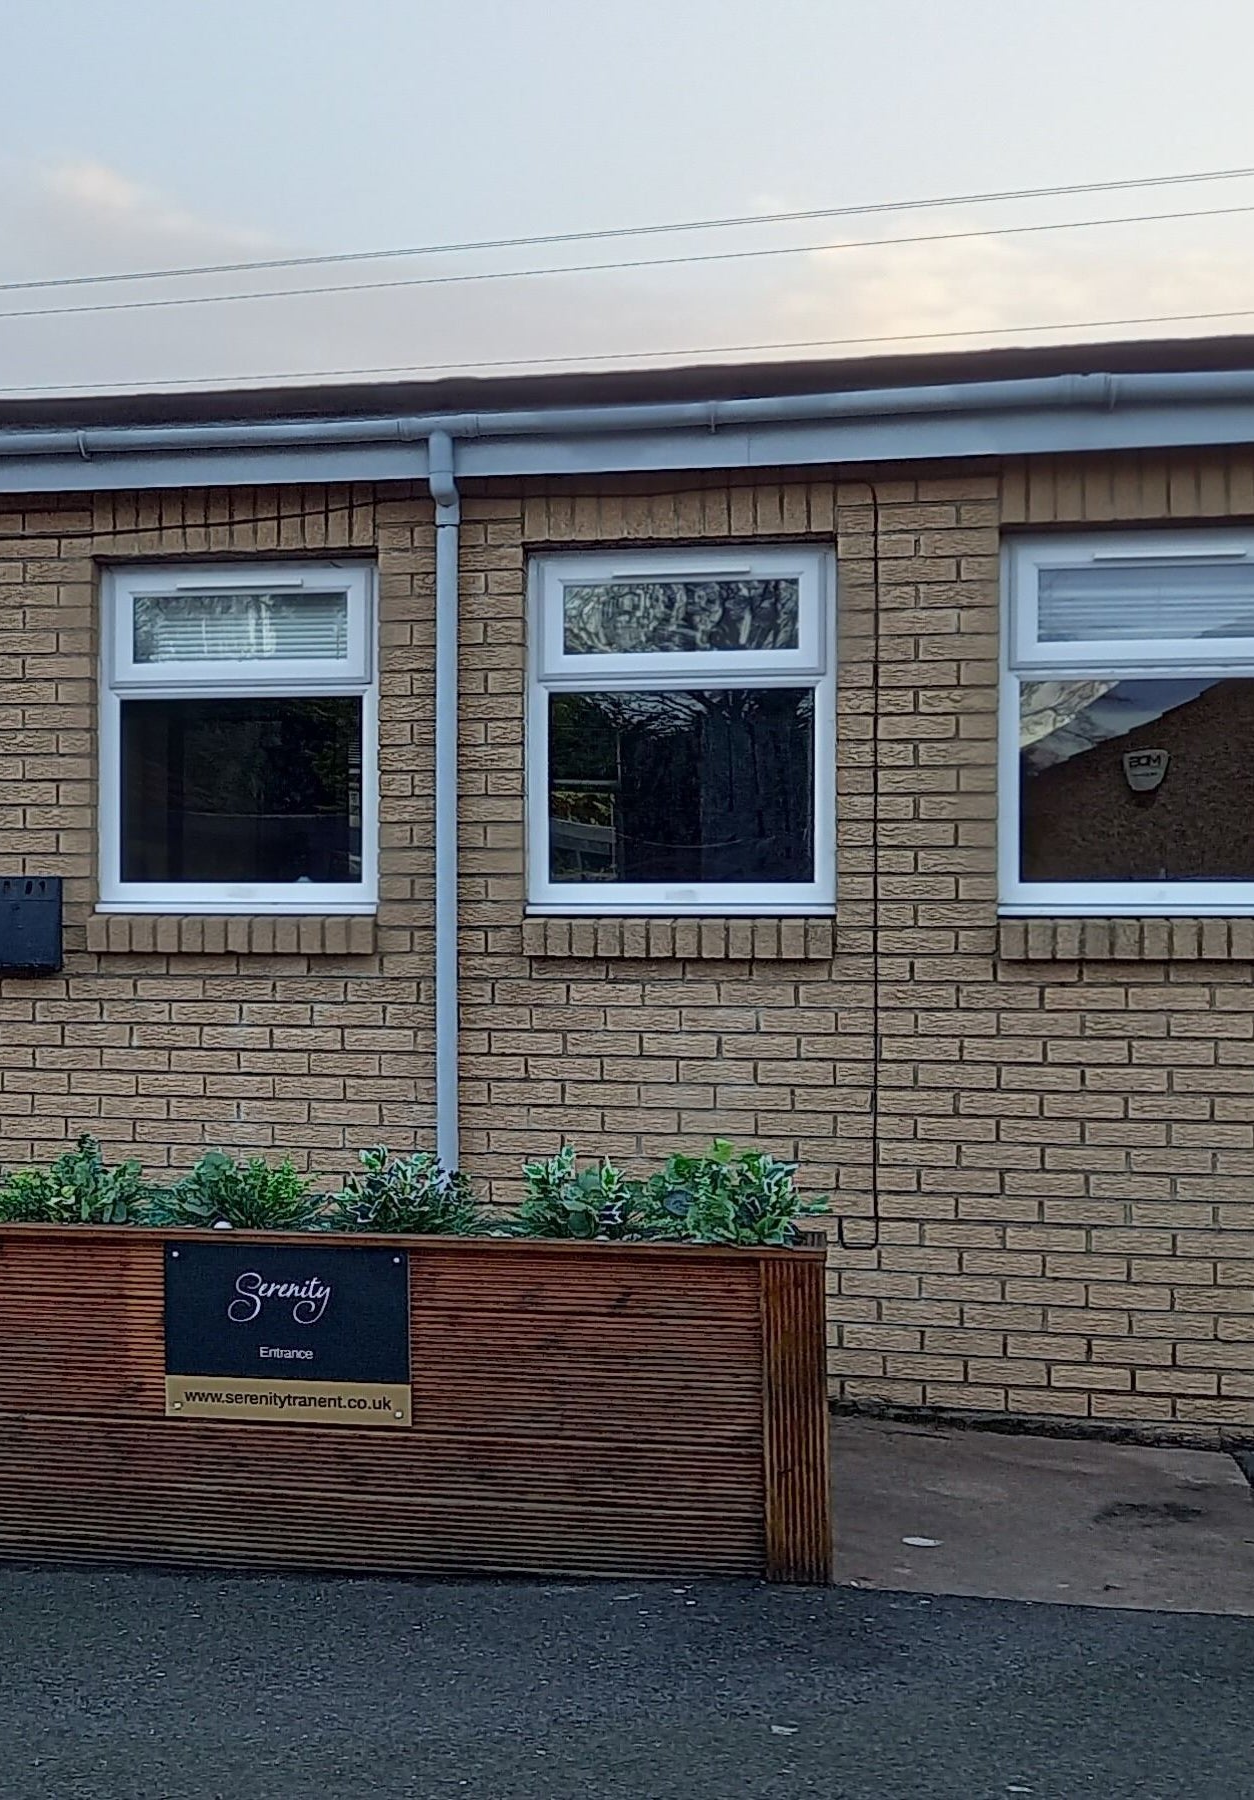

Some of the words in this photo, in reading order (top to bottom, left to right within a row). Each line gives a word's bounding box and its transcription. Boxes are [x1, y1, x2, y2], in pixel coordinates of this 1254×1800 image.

[227, 1272, 331, 1325] Serenity
[259, 1346, 314, 1360] Entrance
[184, 1391, 392, 1410] www.serenitytranent.co.uk
